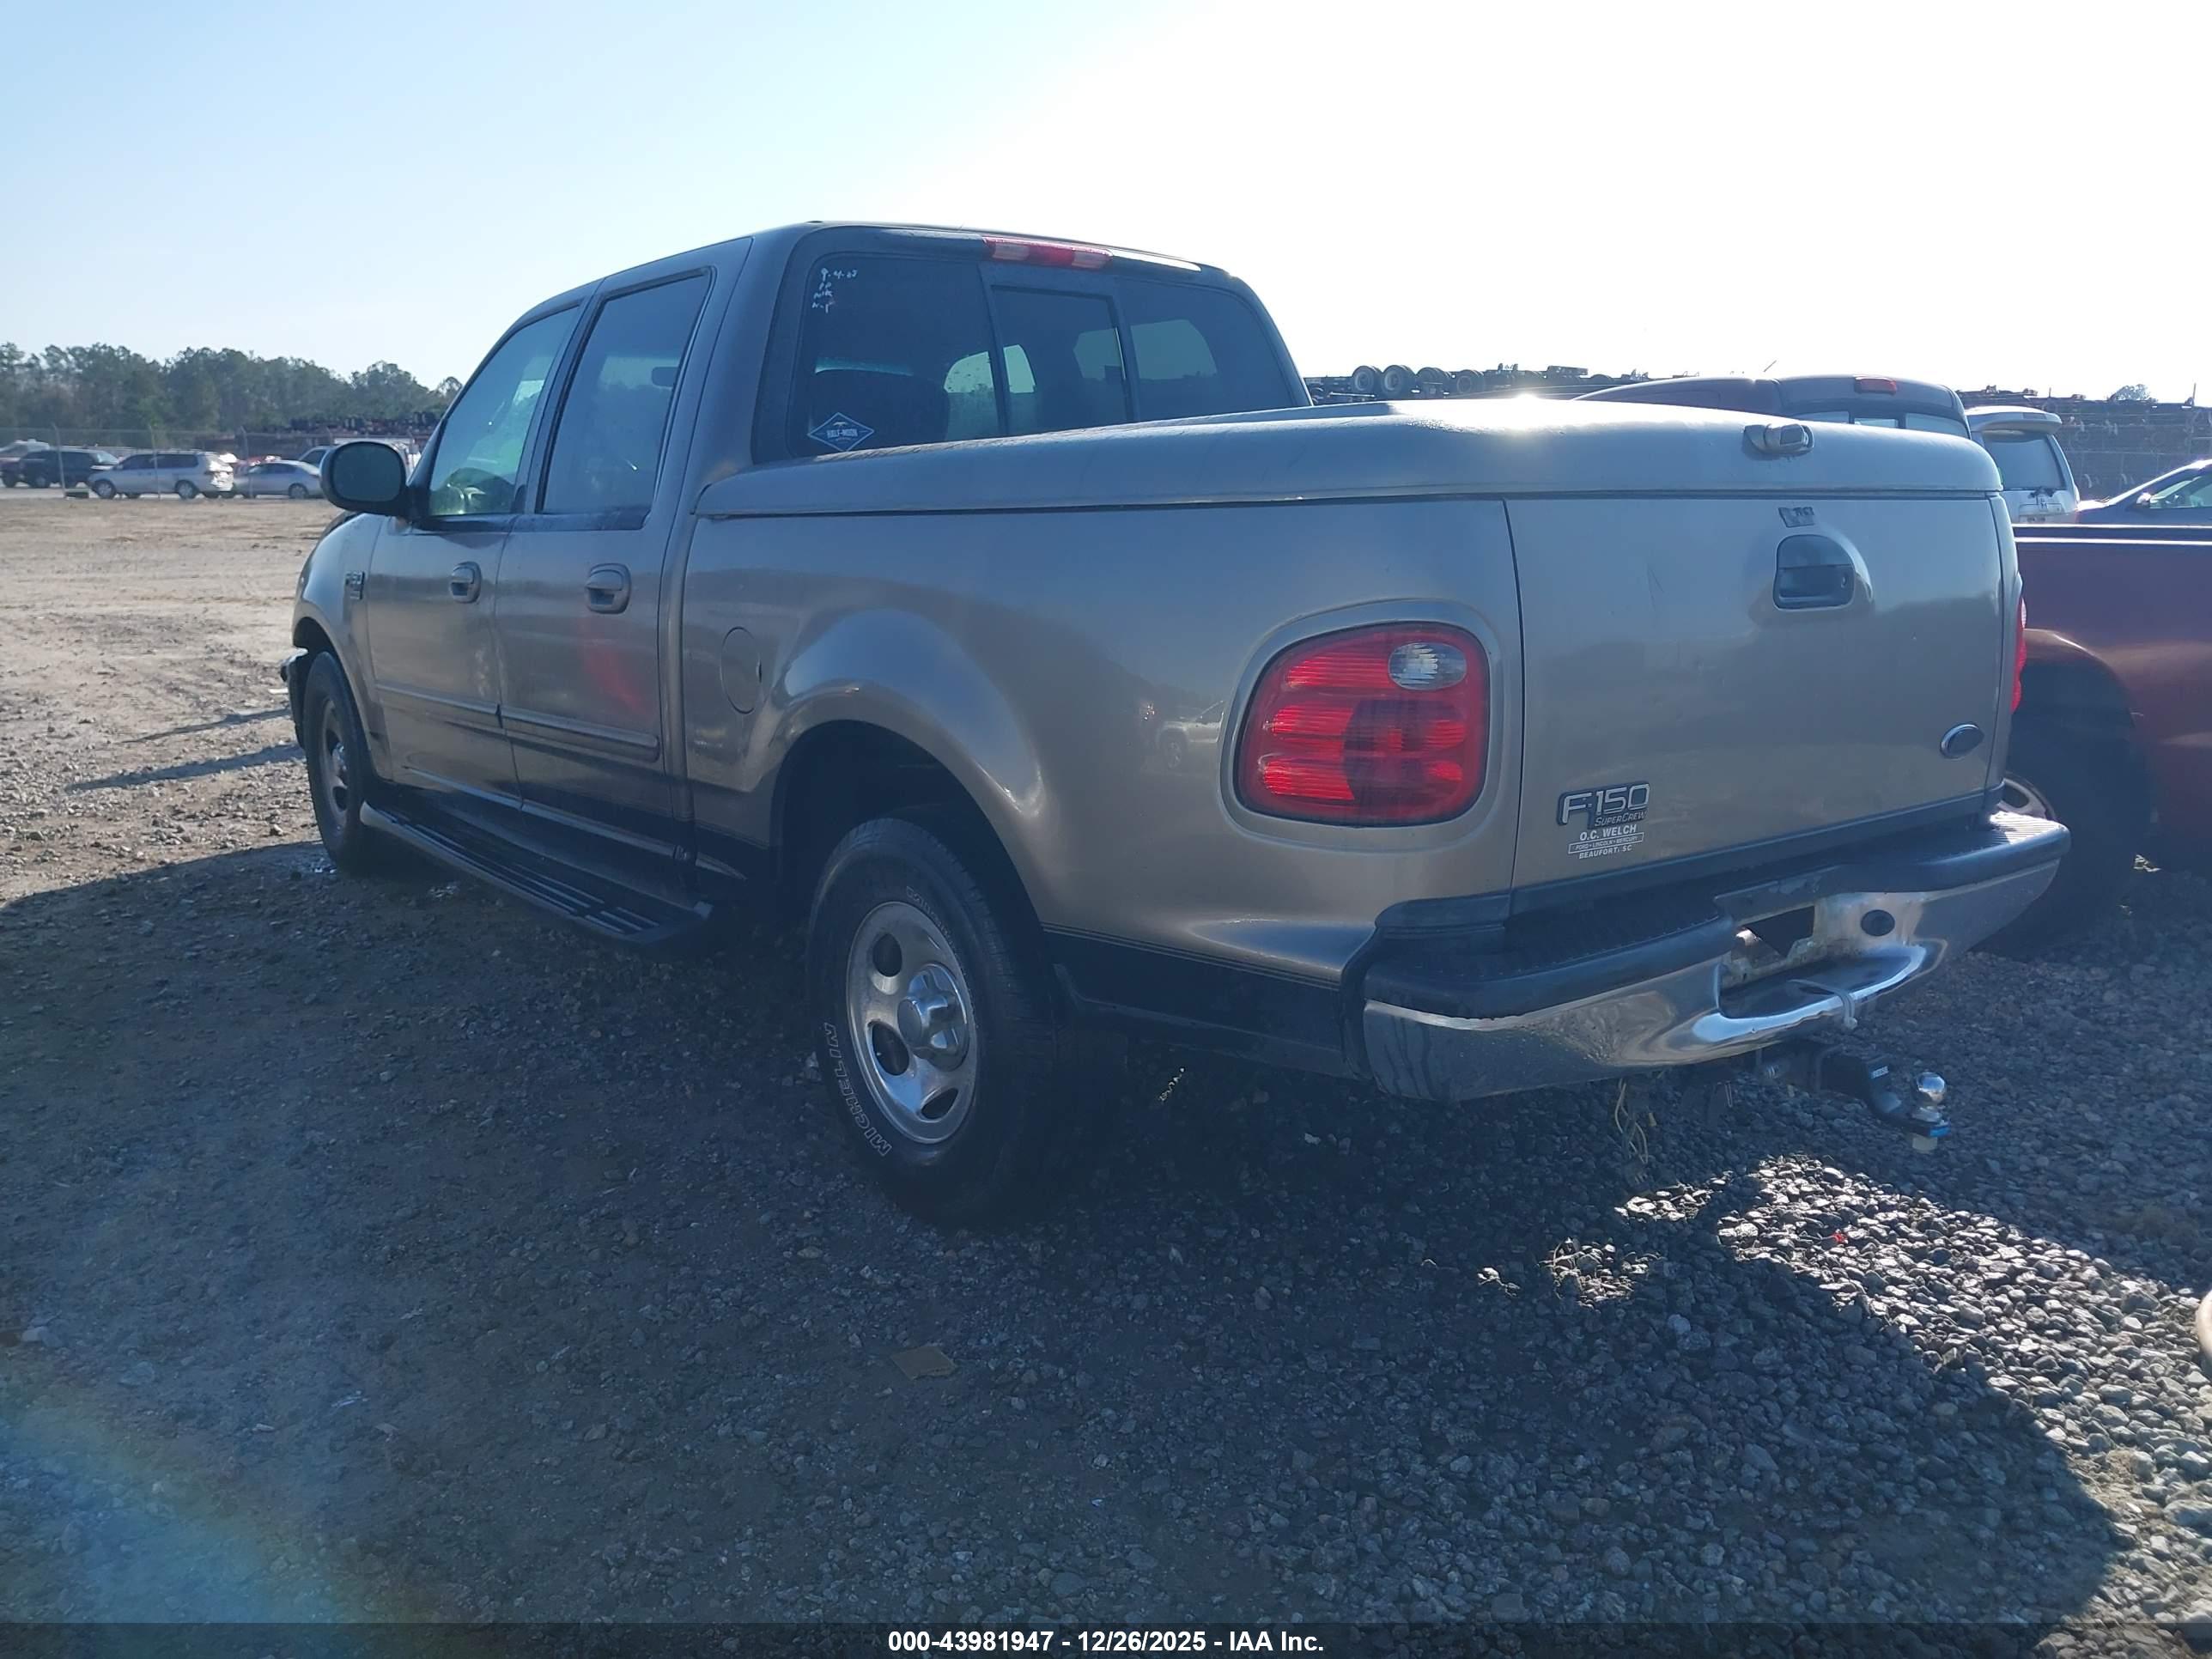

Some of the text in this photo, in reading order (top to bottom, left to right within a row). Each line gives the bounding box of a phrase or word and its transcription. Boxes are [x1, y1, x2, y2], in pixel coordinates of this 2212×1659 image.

[1579, 823, 1637, 841] O.C. WELCH
[823, 1022, 893, 1157] MICHELIN
